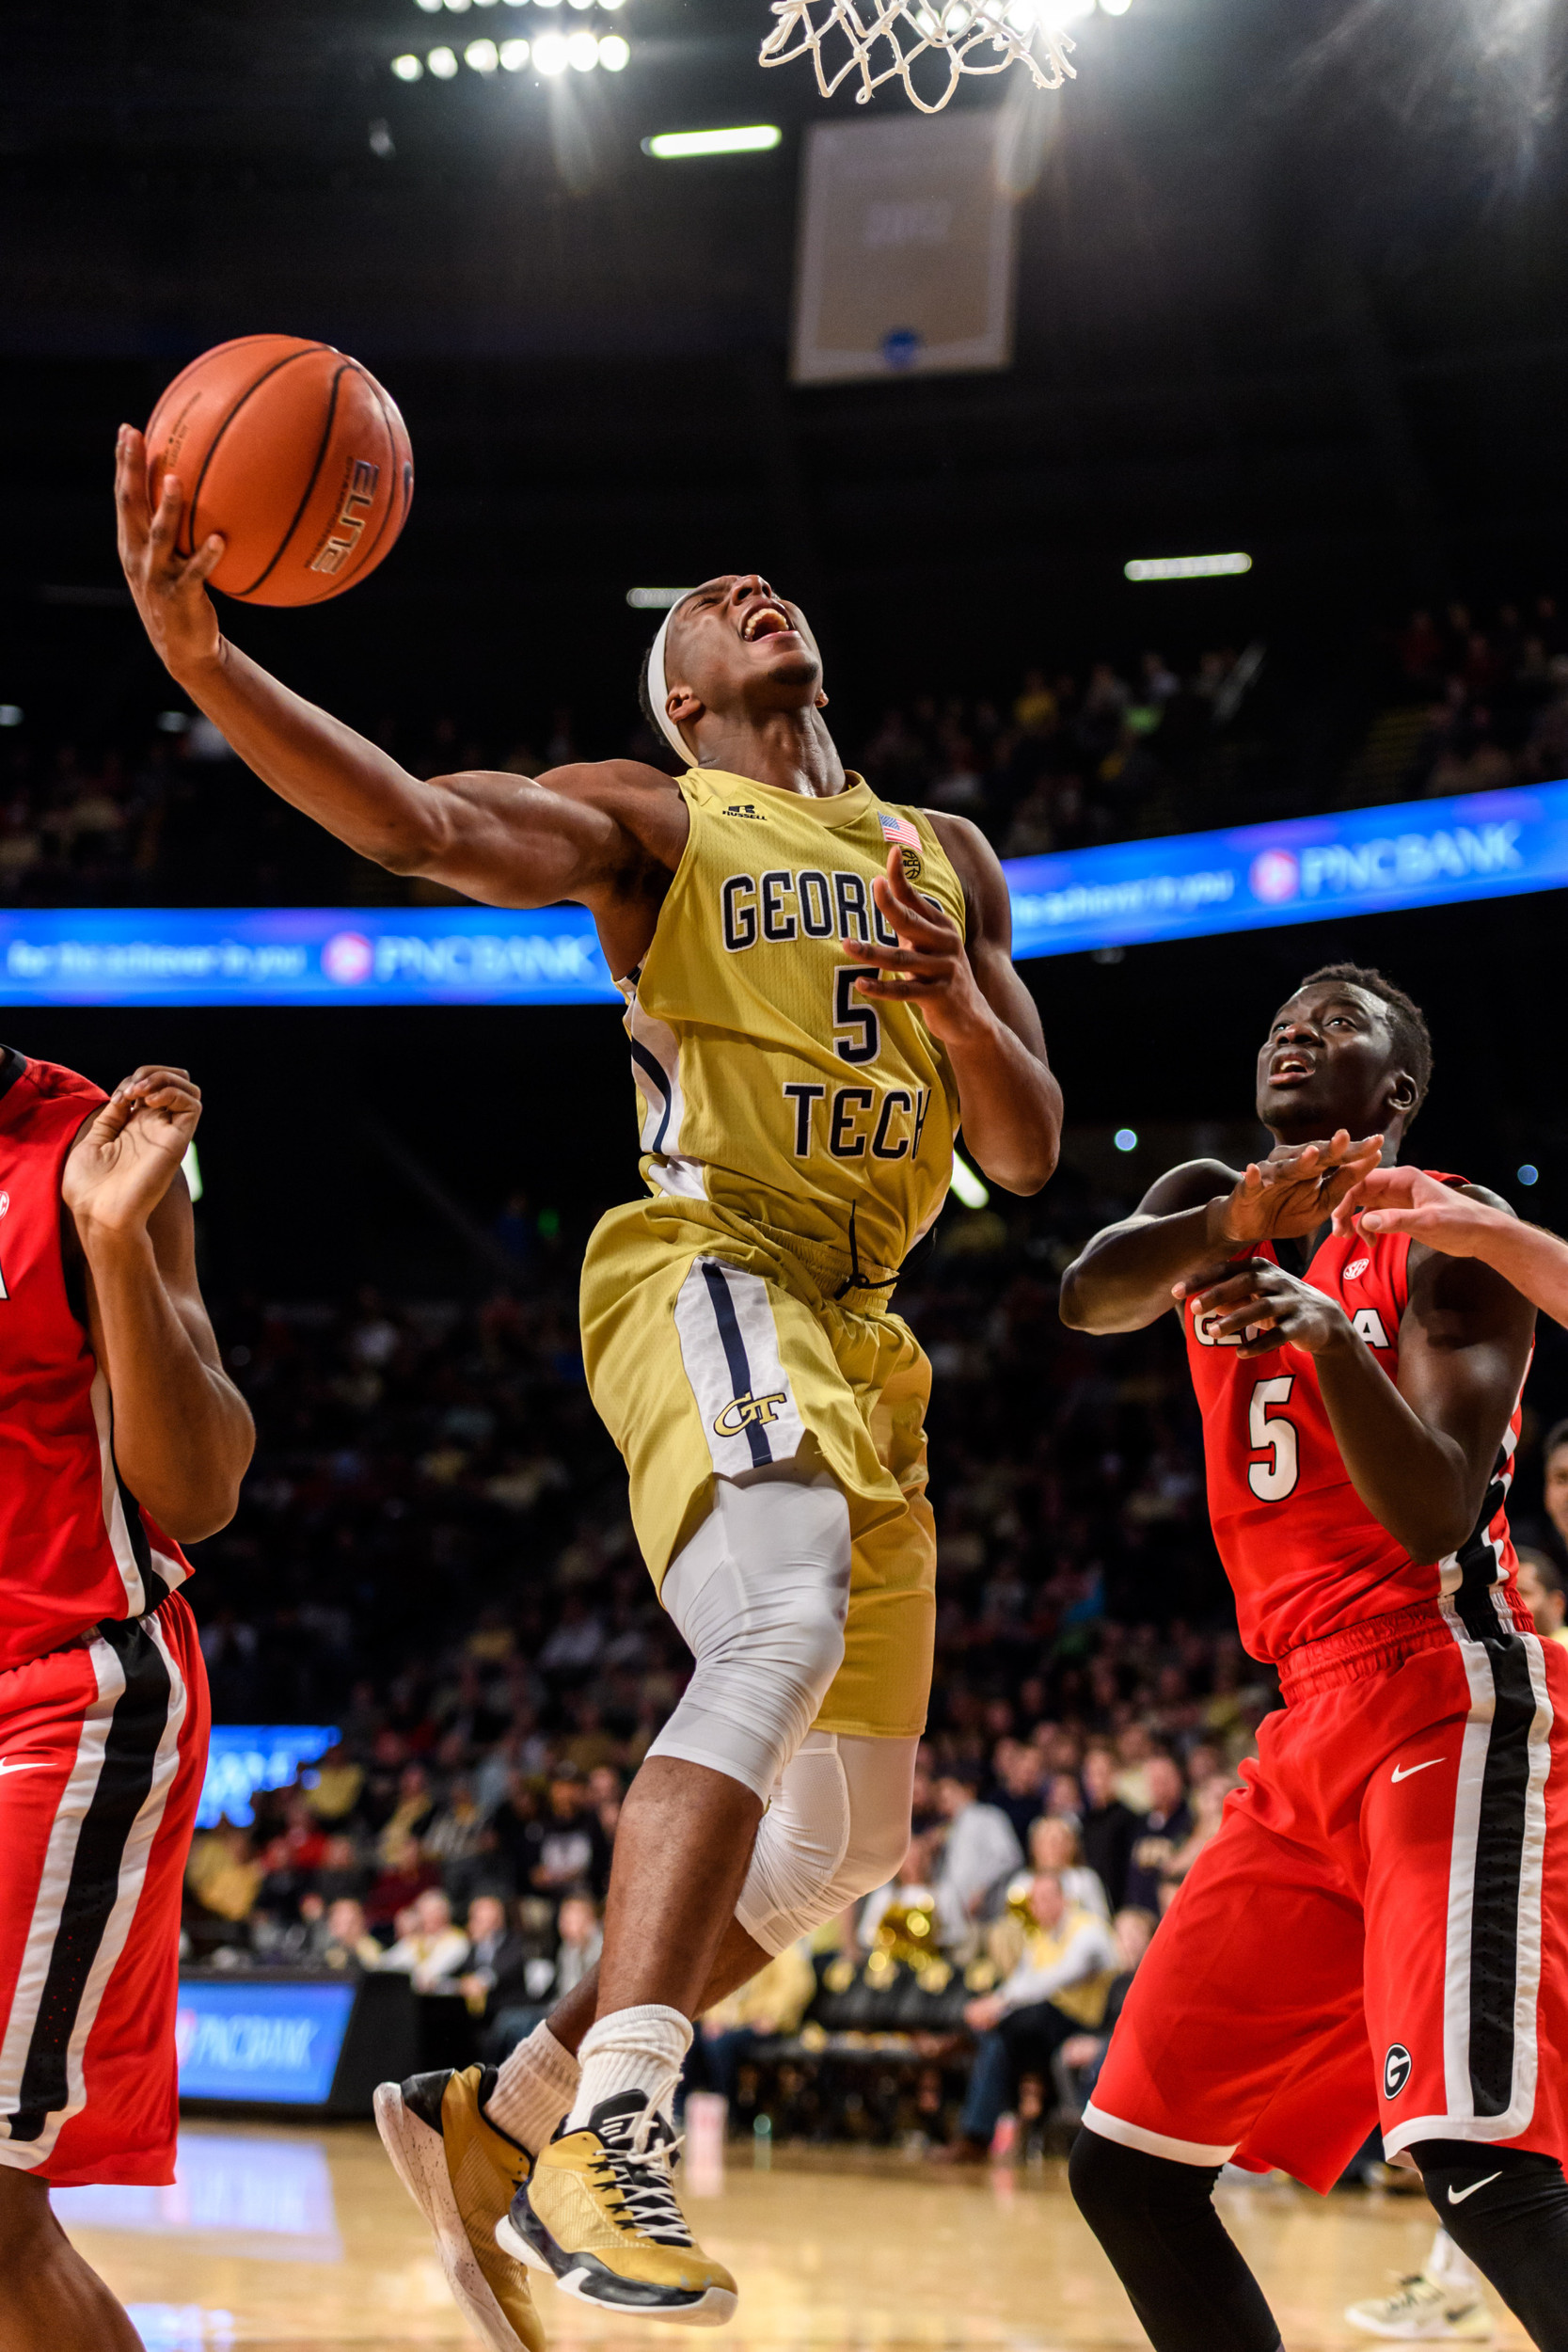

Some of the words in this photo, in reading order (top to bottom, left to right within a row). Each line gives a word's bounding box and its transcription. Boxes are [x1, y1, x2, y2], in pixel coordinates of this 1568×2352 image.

[310, 459, 380, 575] ELITE
[722, 810, 768, 821] RUSSELL
[832, 964, 883, 1067] 5
[783, 1082, 932, 1162] TECH
[1344, 1259, 1369, 1279] SEC
[713, 1391, 787, 1438] GT
[1247, 1375, 1300, 1503] 5
[1384, 2042, 1412, 2101] G
